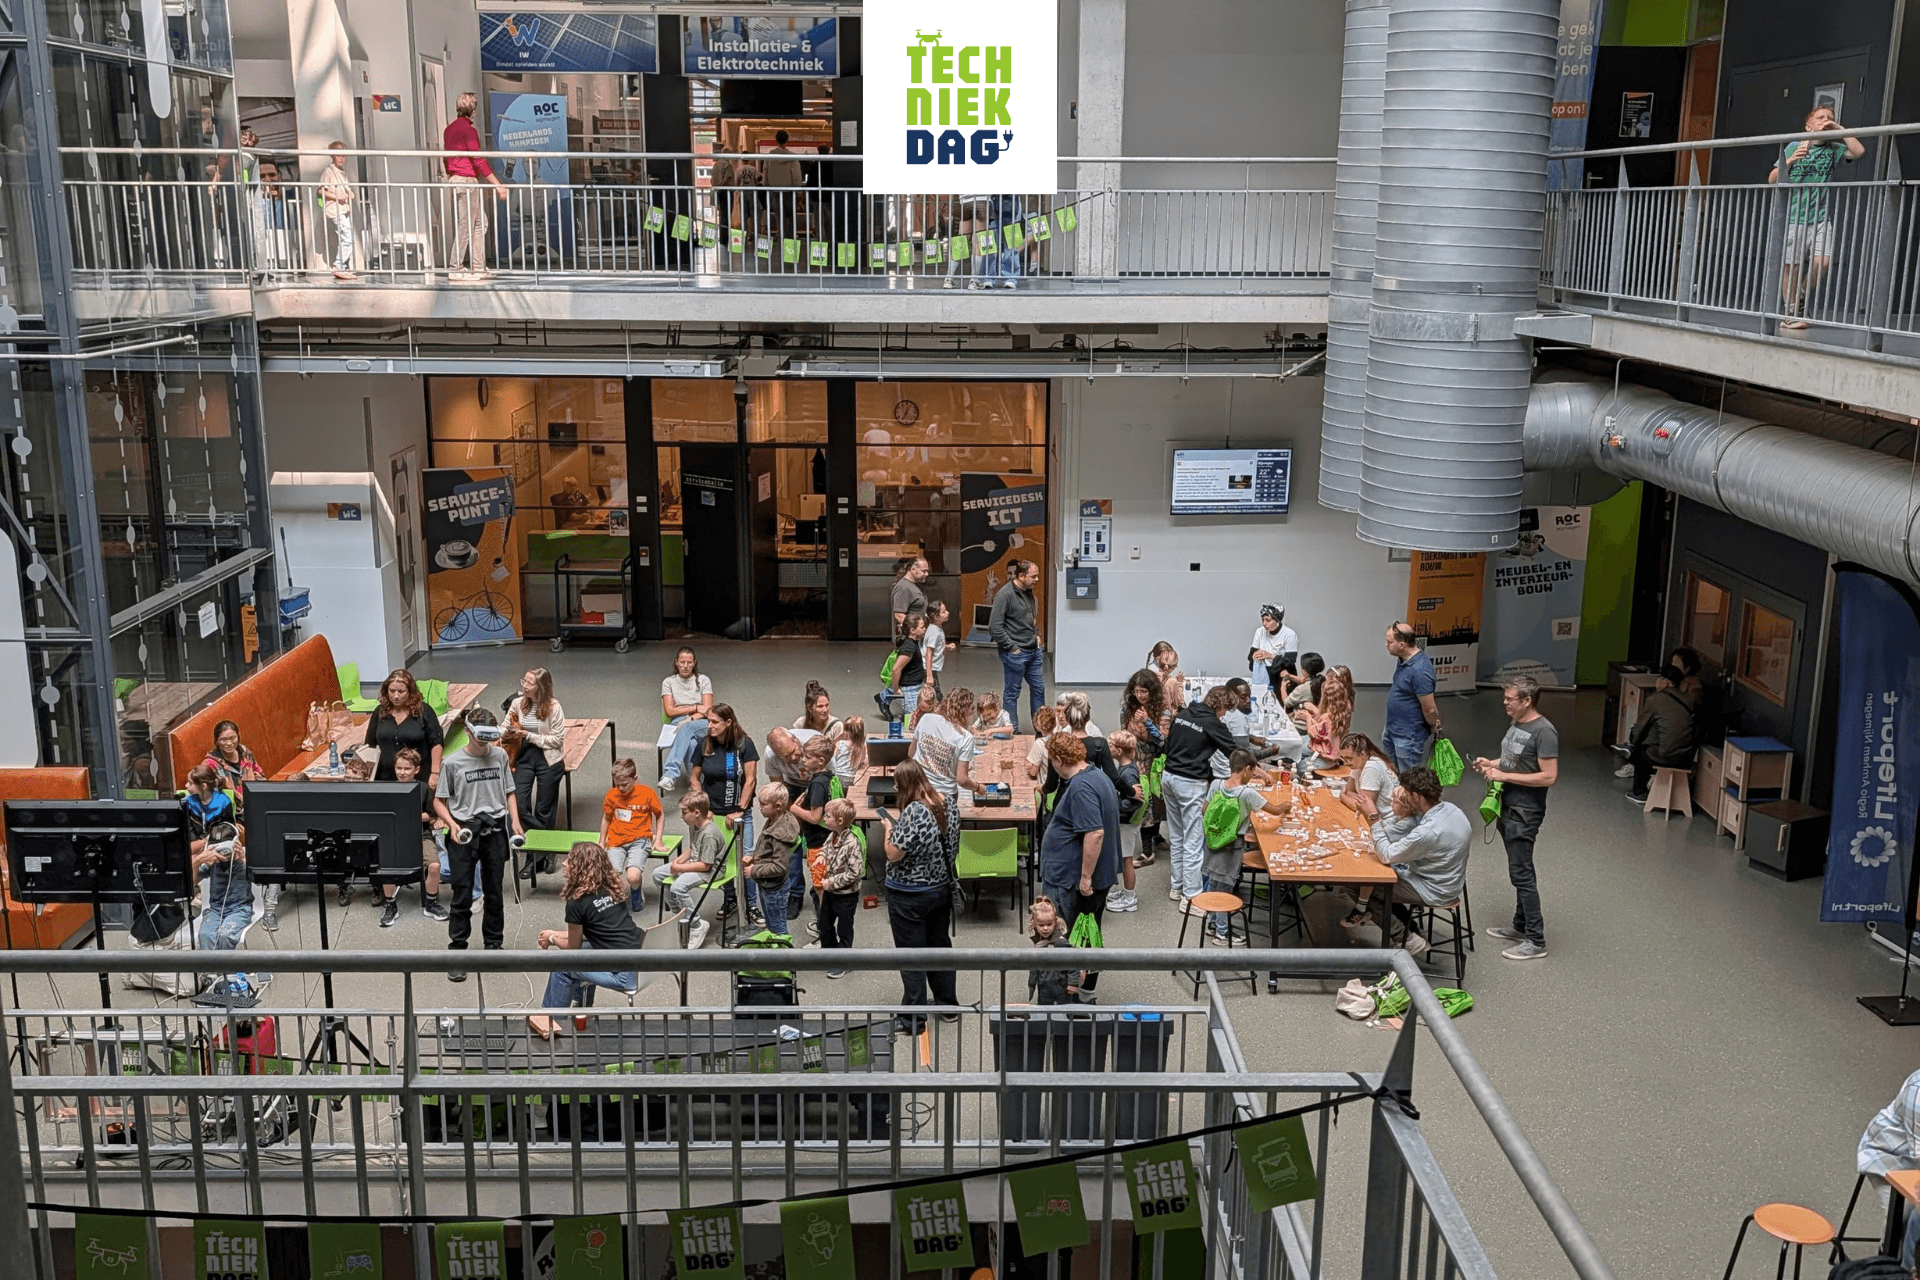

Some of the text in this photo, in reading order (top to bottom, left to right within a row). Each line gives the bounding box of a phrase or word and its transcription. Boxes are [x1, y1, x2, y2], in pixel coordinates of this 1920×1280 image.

[1570, 21, 1595, 40] gek
[709, 39, 811, 53] Installatie- &
[1558, 42, 1593, 58] at je
[698, 56, 824, 71] Elektrotechniek
[1562, 61, 1589, 76] ben
[383, 101, 398, 110] WC
[533, 102, 560, 116] ROC
[502, 128, 553, 141] NEDERLANDS
[508, 136, 550, 149] KAMPIOEN
[427, 487, 505, 512] SERVICE-
[962, 491, 1044, 510] SERVICEDESK
[342, 509, 357, 519] WC
[447, 503, 491, 522] PUNT
[987, 507, 1023, 527] ICT
[1083, 506, 1097, 515] WC
[1555, 514, 1581, 526] ROC
[1420, 552, 1458, 561] TOEKOMST
[1420, 562, 1444, 572] BOUW.
[1495, 560, 1572, 577] MEUBEL- EN
[1495, 571, 1574, 588] INTERIEUR-
[1517, 583, 1553, 595] BOUW
[593, 896, 613, 908] Enjoy
[803, 1045, 820, 1055] ECH
[123, 1065, 142, 1073] DAG
[1133, 1159, 1185, 1184] TECH
[1136, 1178, 1188, 1202] NIEK
[907, 1198, 959, 1220] TECH
[1140, 1197, 1186, 1218] DAG
[680, 1217, 731, 1238] TECH
[911, 1216, 961, 1239] NIEK
[205, 1237, 258, 1254] TECH
[447, 1240, 499, 1259] TECH
[682, 1234, 733, 1255] NIEK
[913, 1235, 959, 1255] DAG
[206, 1255, 258, 1272] NIEK
[448, 1258, 500, 1277] NIEK
[685, 1253, 730, 1270] DAG
